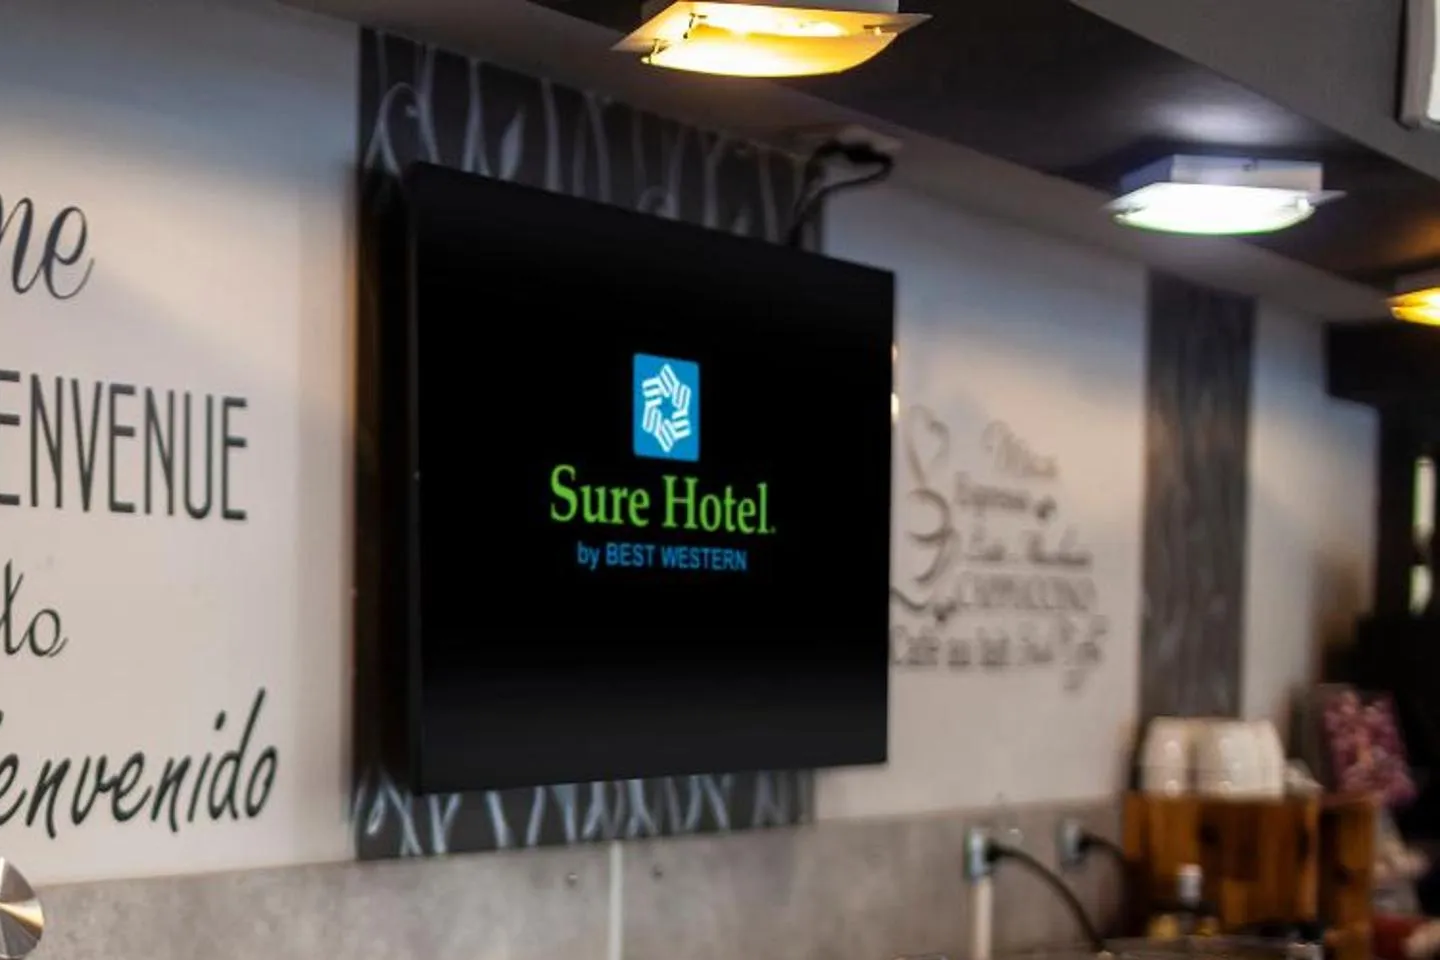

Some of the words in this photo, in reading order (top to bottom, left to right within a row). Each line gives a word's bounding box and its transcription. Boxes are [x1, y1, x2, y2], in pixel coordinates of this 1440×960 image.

[549, 463, 651, 528] Sure
[576, 540, 601, 571] by
[605, 542, 656, 568] BEST
[661, 546, 748, 571] WESTERN
